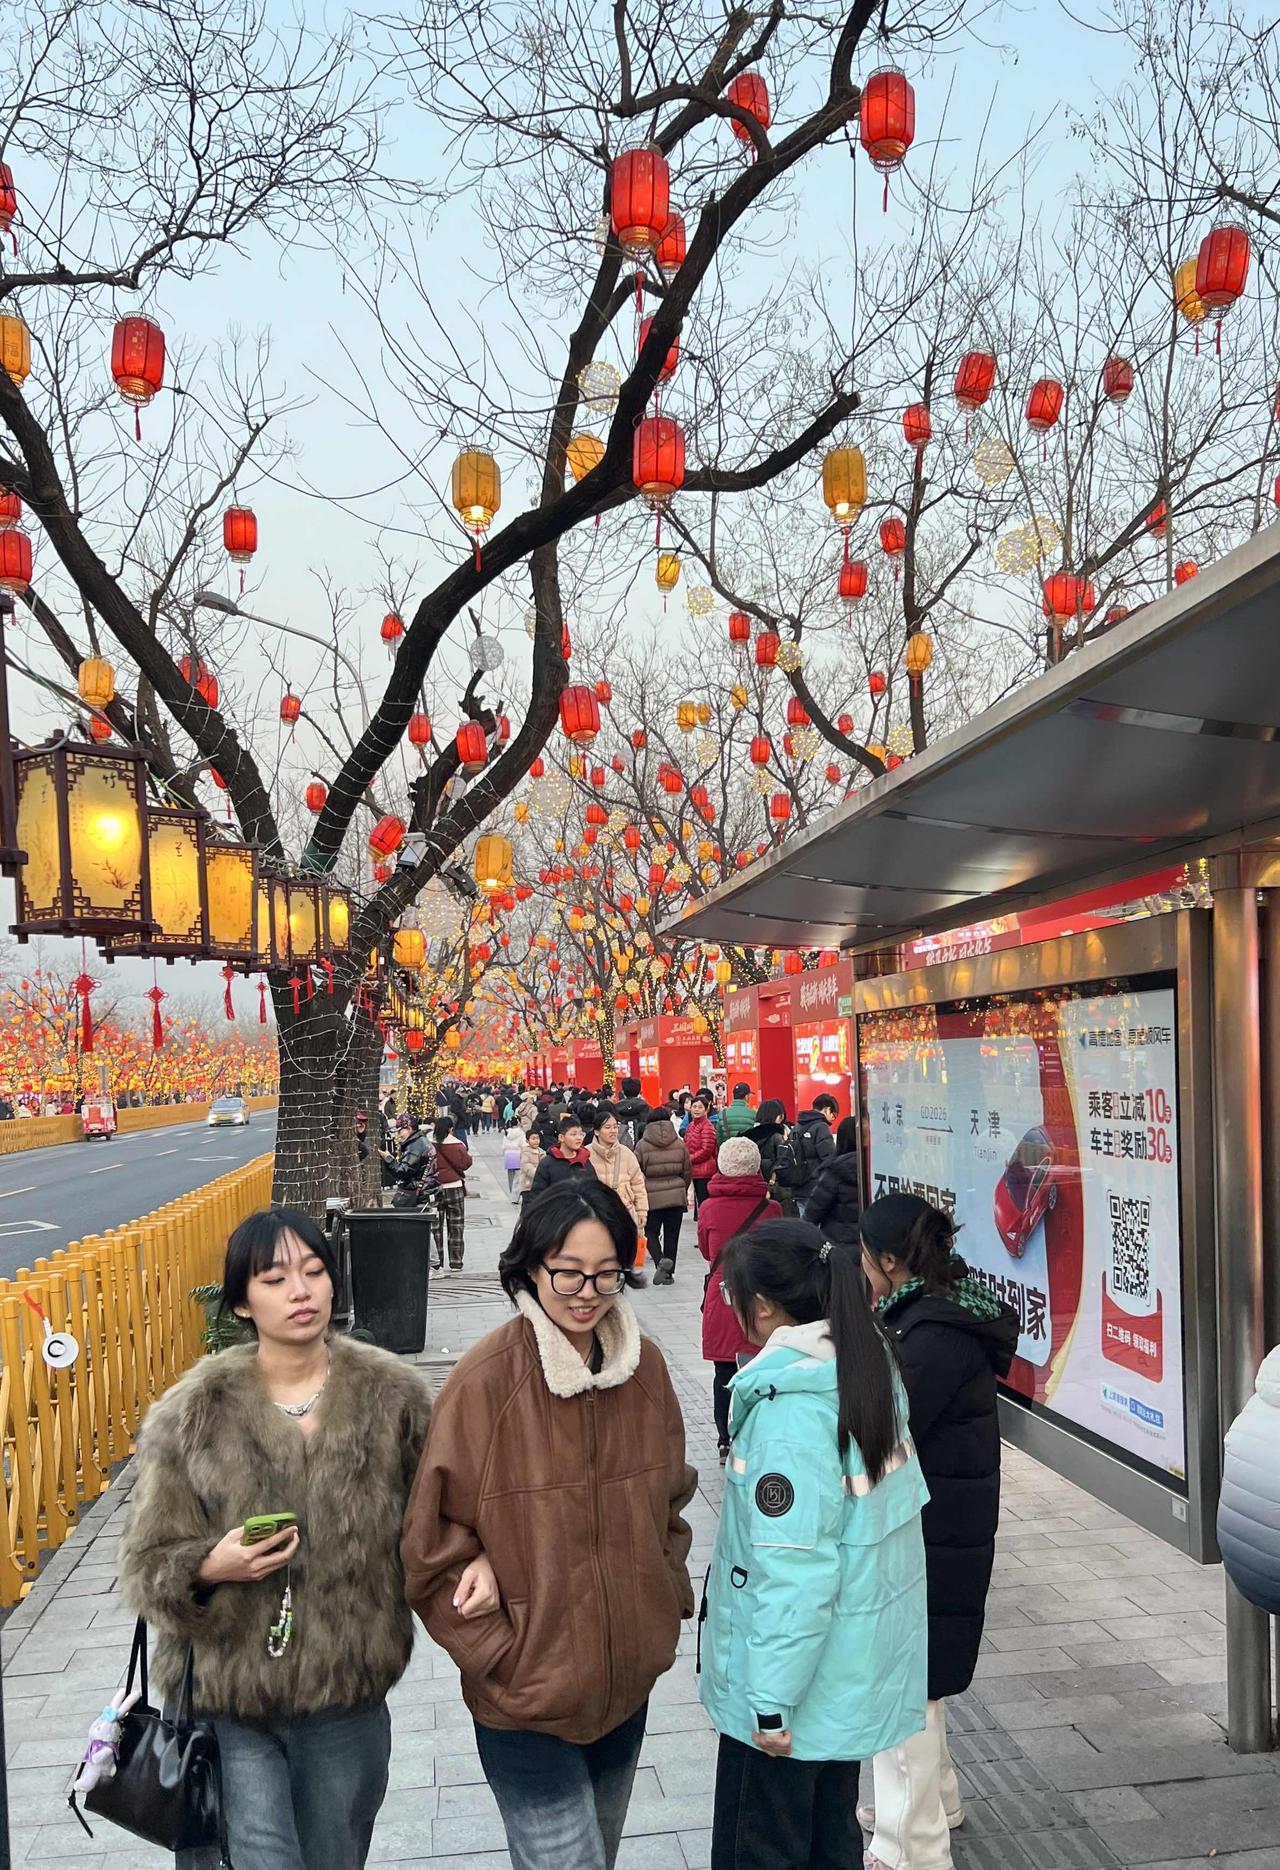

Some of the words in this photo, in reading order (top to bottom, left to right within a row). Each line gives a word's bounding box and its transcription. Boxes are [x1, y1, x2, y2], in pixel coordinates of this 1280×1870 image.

[103, 772, 116, 789] 竹
[882, 1101, 903, 1126] 北京
[970, 1109, 1001, 1138] 天津
